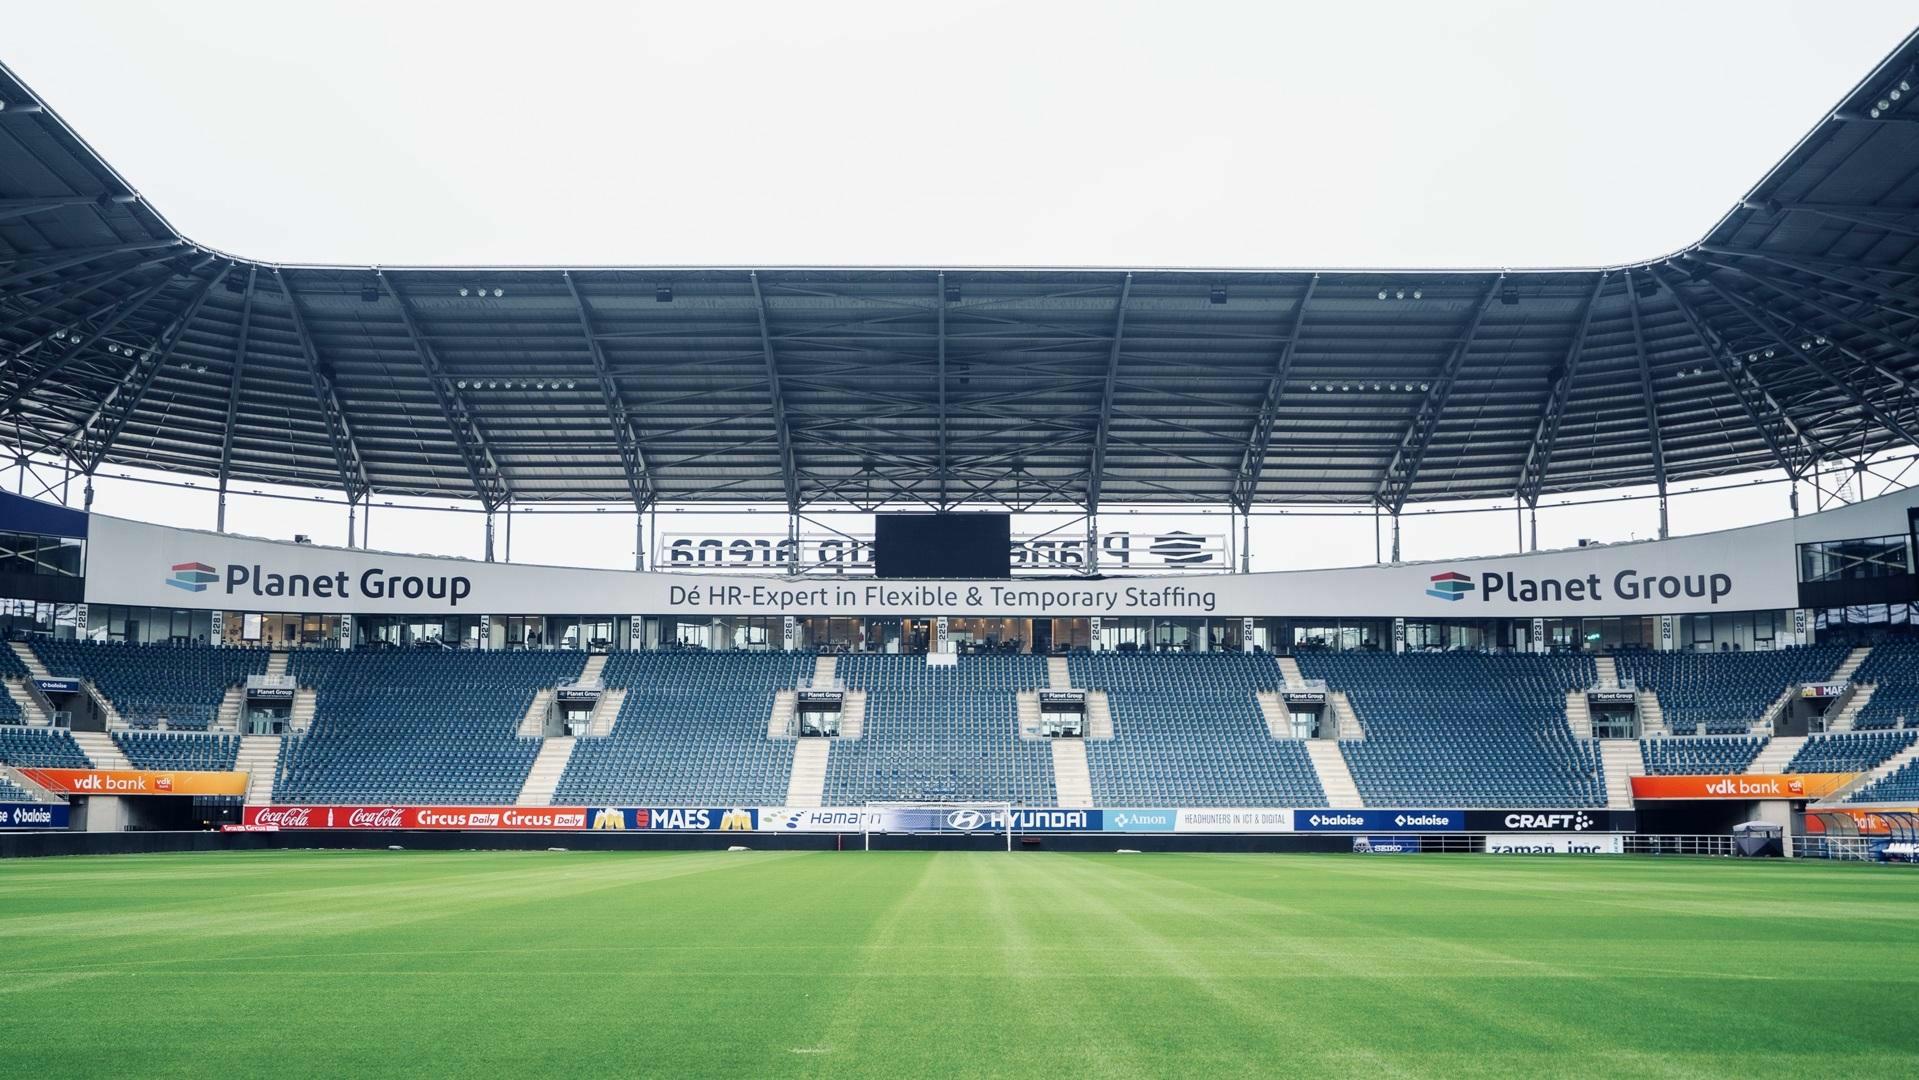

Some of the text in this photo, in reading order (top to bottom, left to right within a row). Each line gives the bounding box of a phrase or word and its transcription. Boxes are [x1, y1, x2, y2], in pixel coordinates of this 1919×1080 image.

[226, 565, 471, 606] Planet Group
[1482, 570, 1732, 604] Planet Group
[669, 585, 1216, 611] Dé HR-Expert in Flexible & Temporary Staffing
[74, 775, 146, 790] vdk bank
[1705, 779, 1779, 794] vdk bank
[22, 808, 50, 823] baloise
[255, 808, 312, 826] Coca-Cola
[349, 808, 405, 827] Coca-Cola
[417, 810, 495, 826] Circus Daily
[502, 811, 581, 826] Circus Daily
[651, 809, 710, 829] MAES
[990, 810, 1087, 828] HYUNDAI
[1129, 814, 1166, 825] Amon
[1184, 814, 1286, 824] HEADHUNTERS IN ICT & DIGITAL
[1321, 814, 1364, 826] baloise
[1407, 814, 1449, 826] baloise
[1504, 814, 1574, 829] CRAFT
